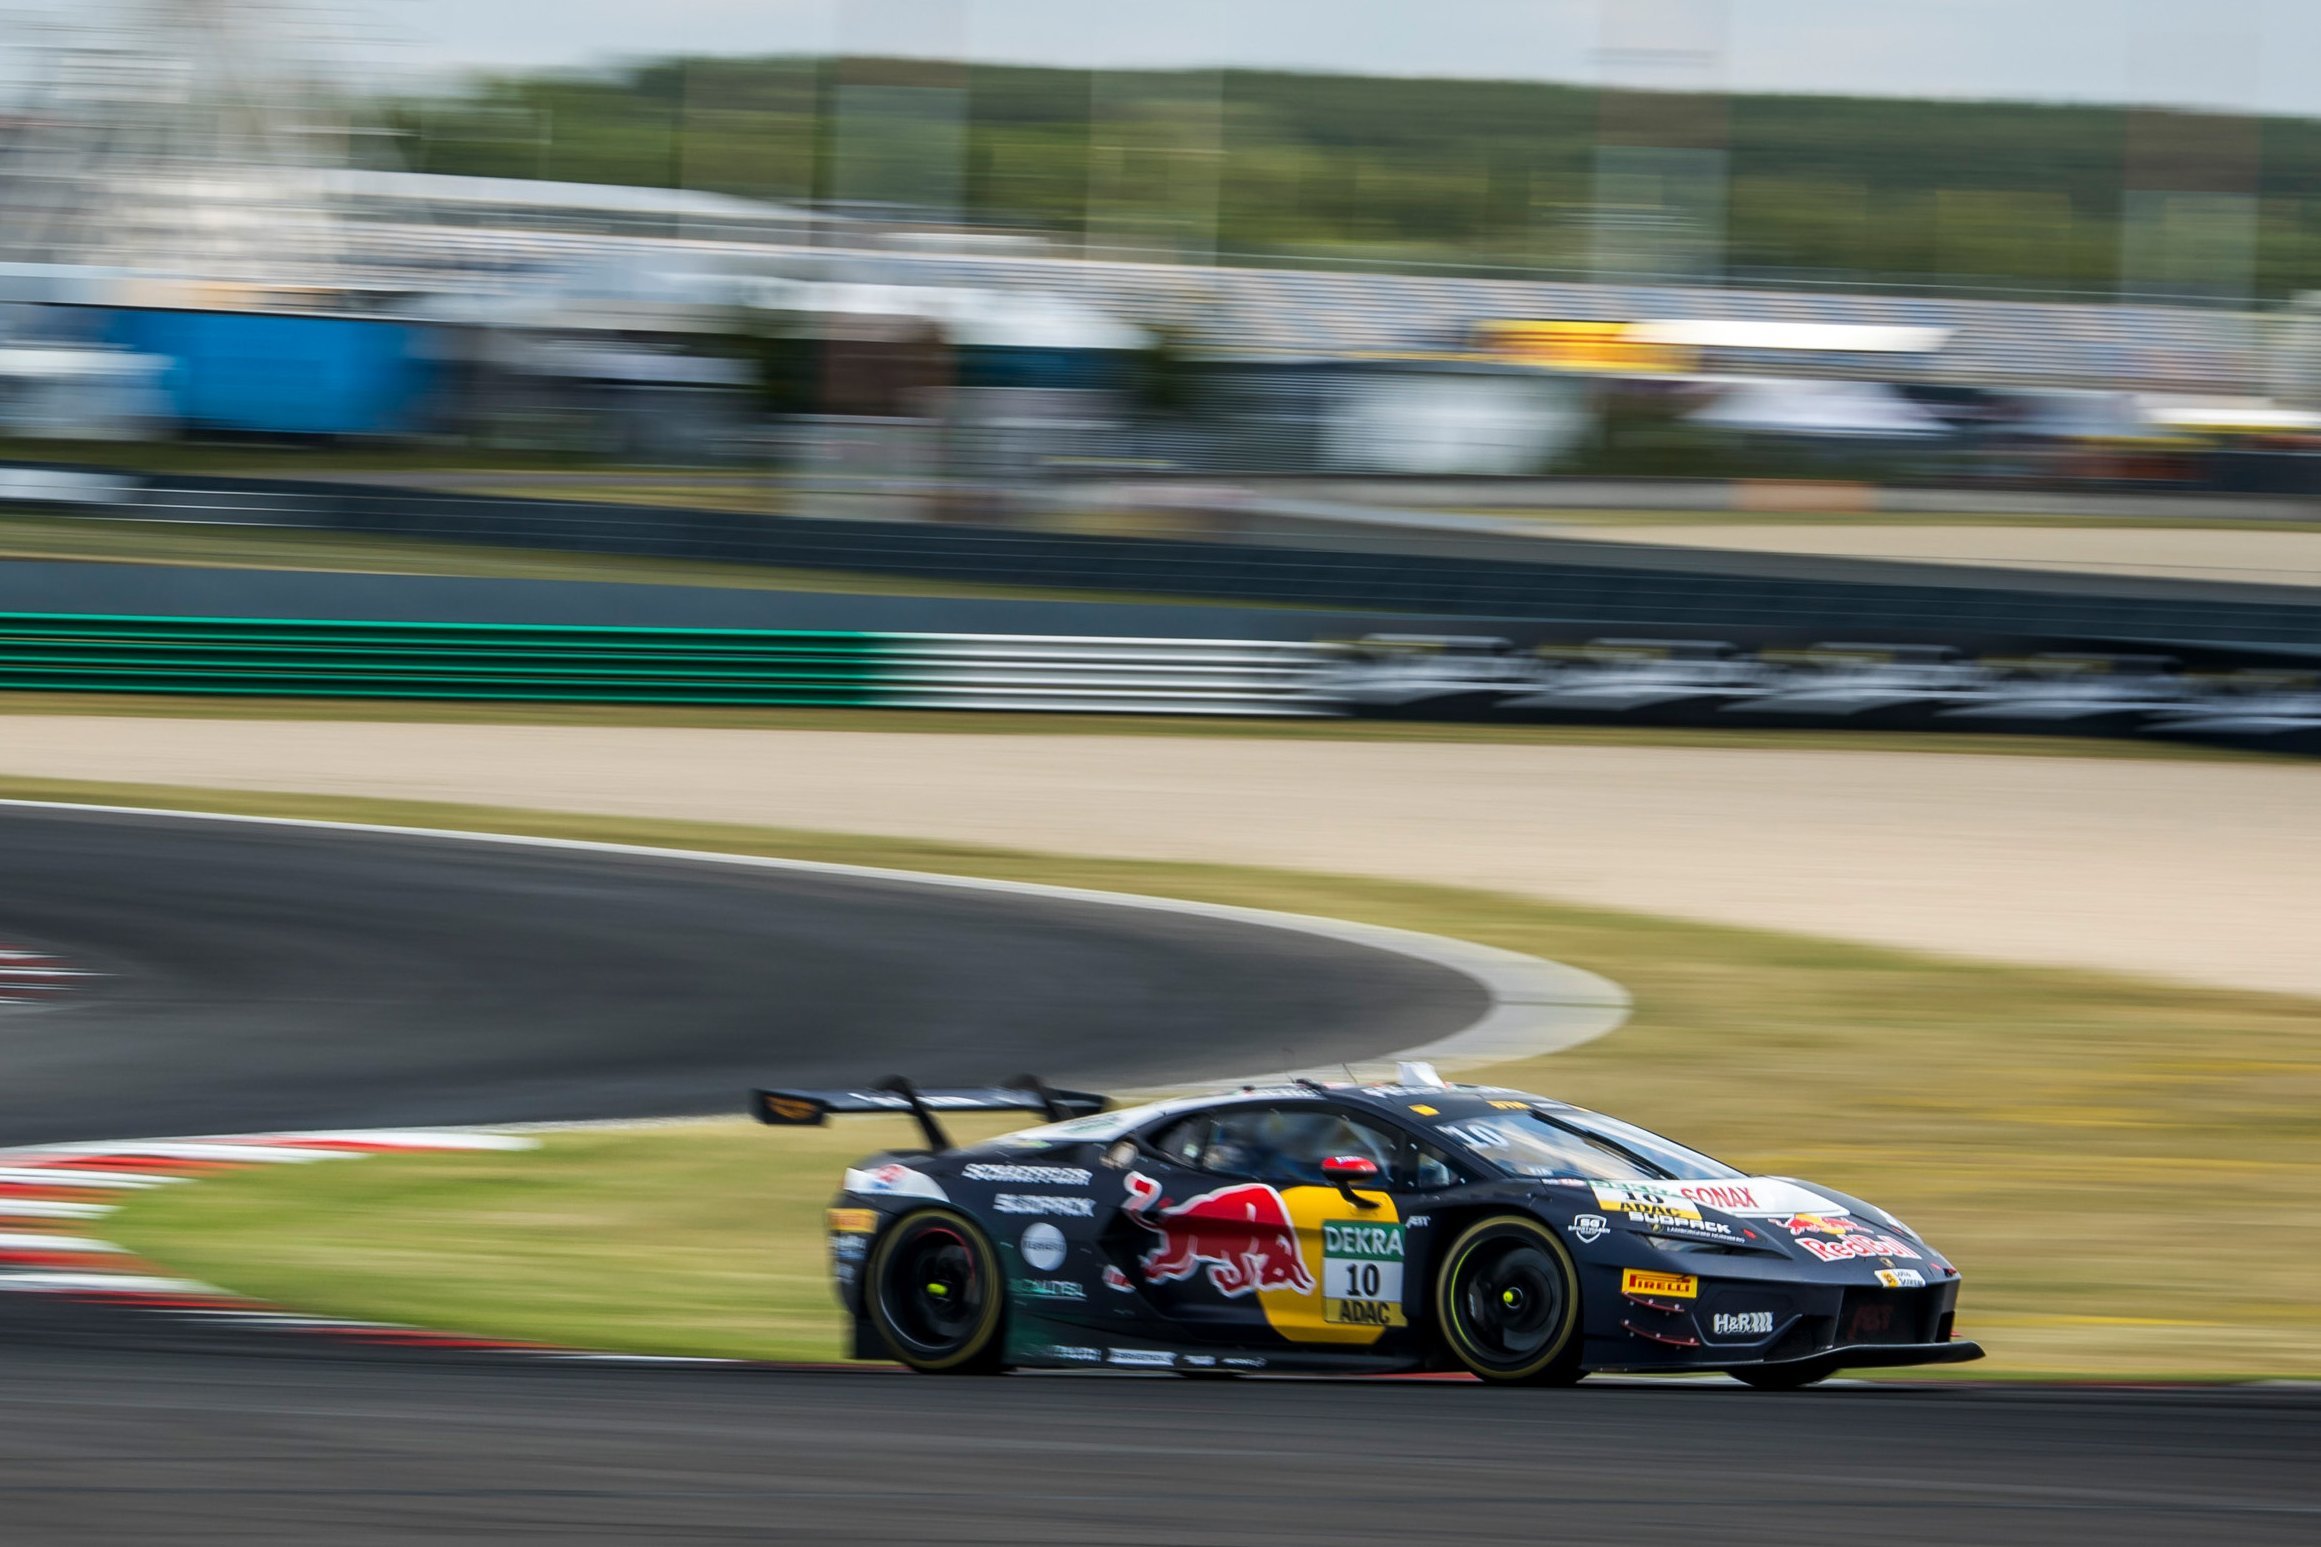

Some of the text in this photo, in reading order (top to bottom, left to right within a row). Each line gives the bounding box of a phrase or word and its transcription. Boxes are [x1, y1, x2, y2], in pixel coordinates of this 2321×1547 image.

[1436, 1124, 1510, 1149] 10
[1623, 1191, 1664, 1204] 10
[1681, 1186, 1759, 1209] SONAX
[1620, 1202, 1681, 1217] ADAC
[1323, 1226, 1404, 1256] DEKRA
[1346, 1263, 1380, 1297] 10
[1629, 1273, 1691, 1292] PIRELLI
[1341, 1300, 1389, 1324] ADAC
